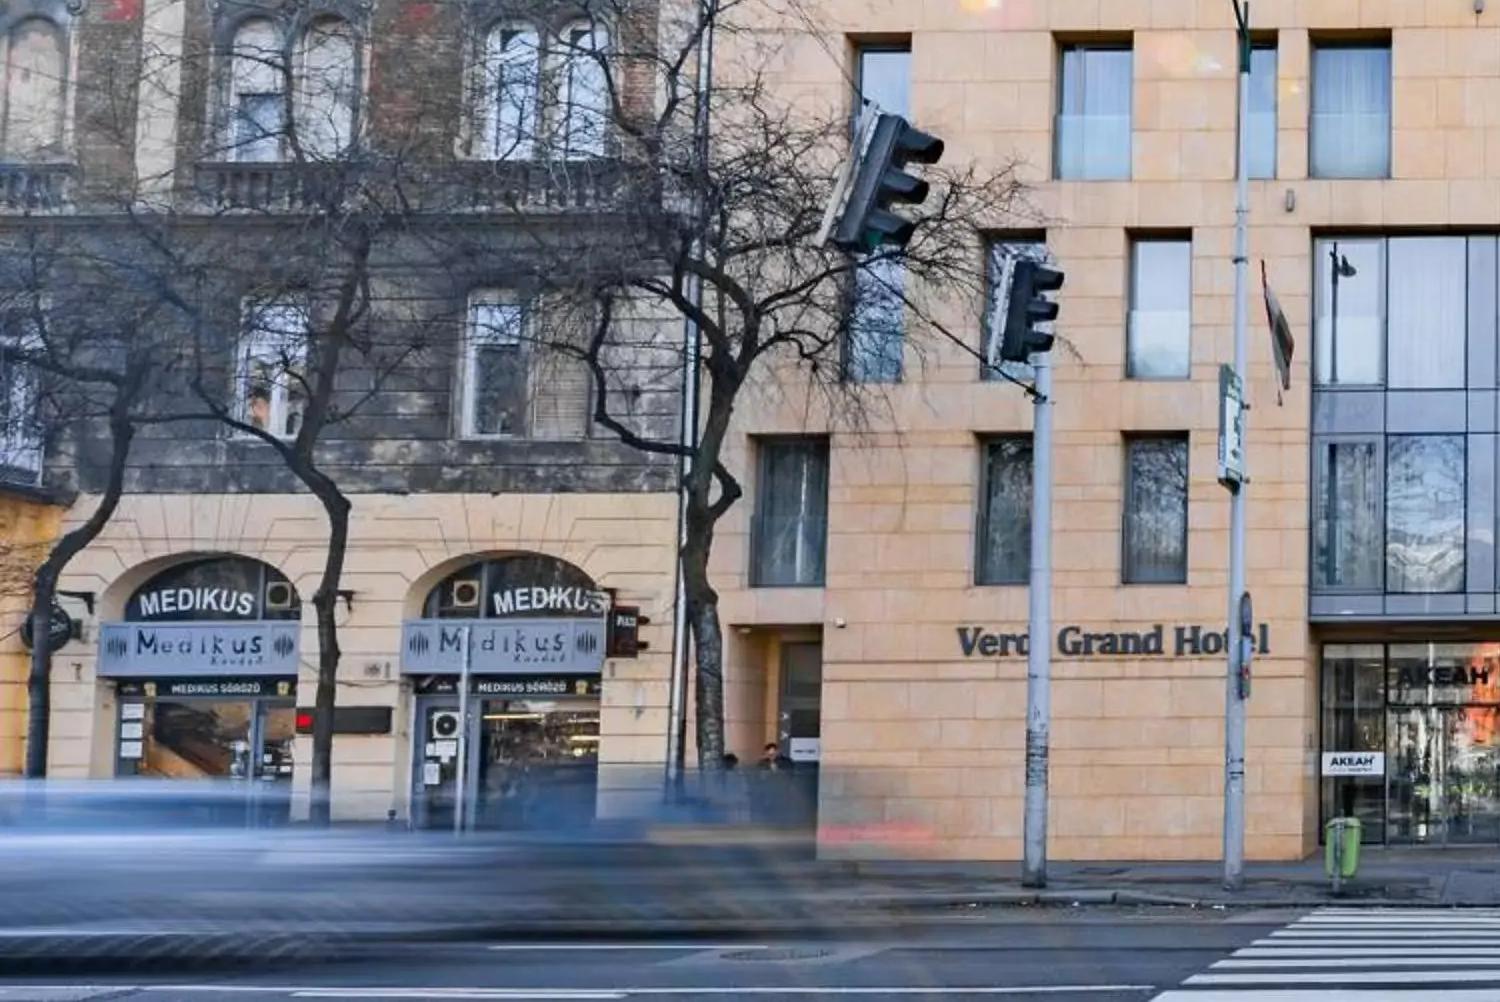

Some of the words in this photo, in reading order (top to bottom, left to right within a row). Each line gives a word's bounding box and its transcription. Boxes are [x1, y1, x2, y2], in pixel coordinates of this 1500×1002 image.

[140, 587, 256, 616] MEDIKUS
[493, 586, 607, 615] MEDIKUS
[137, 630, 263, 655] Medikus
[439, 628, 566, 653] Mdikus
[957, 624, 1031, 657] Verd
[1057, 624, 1165, 656] Grand
[171, 682, 219, 694] MEDIKUS
[478, 682, 525, 693] MEDIKUS
[1330, 756, 1373, 766] AKEAH
